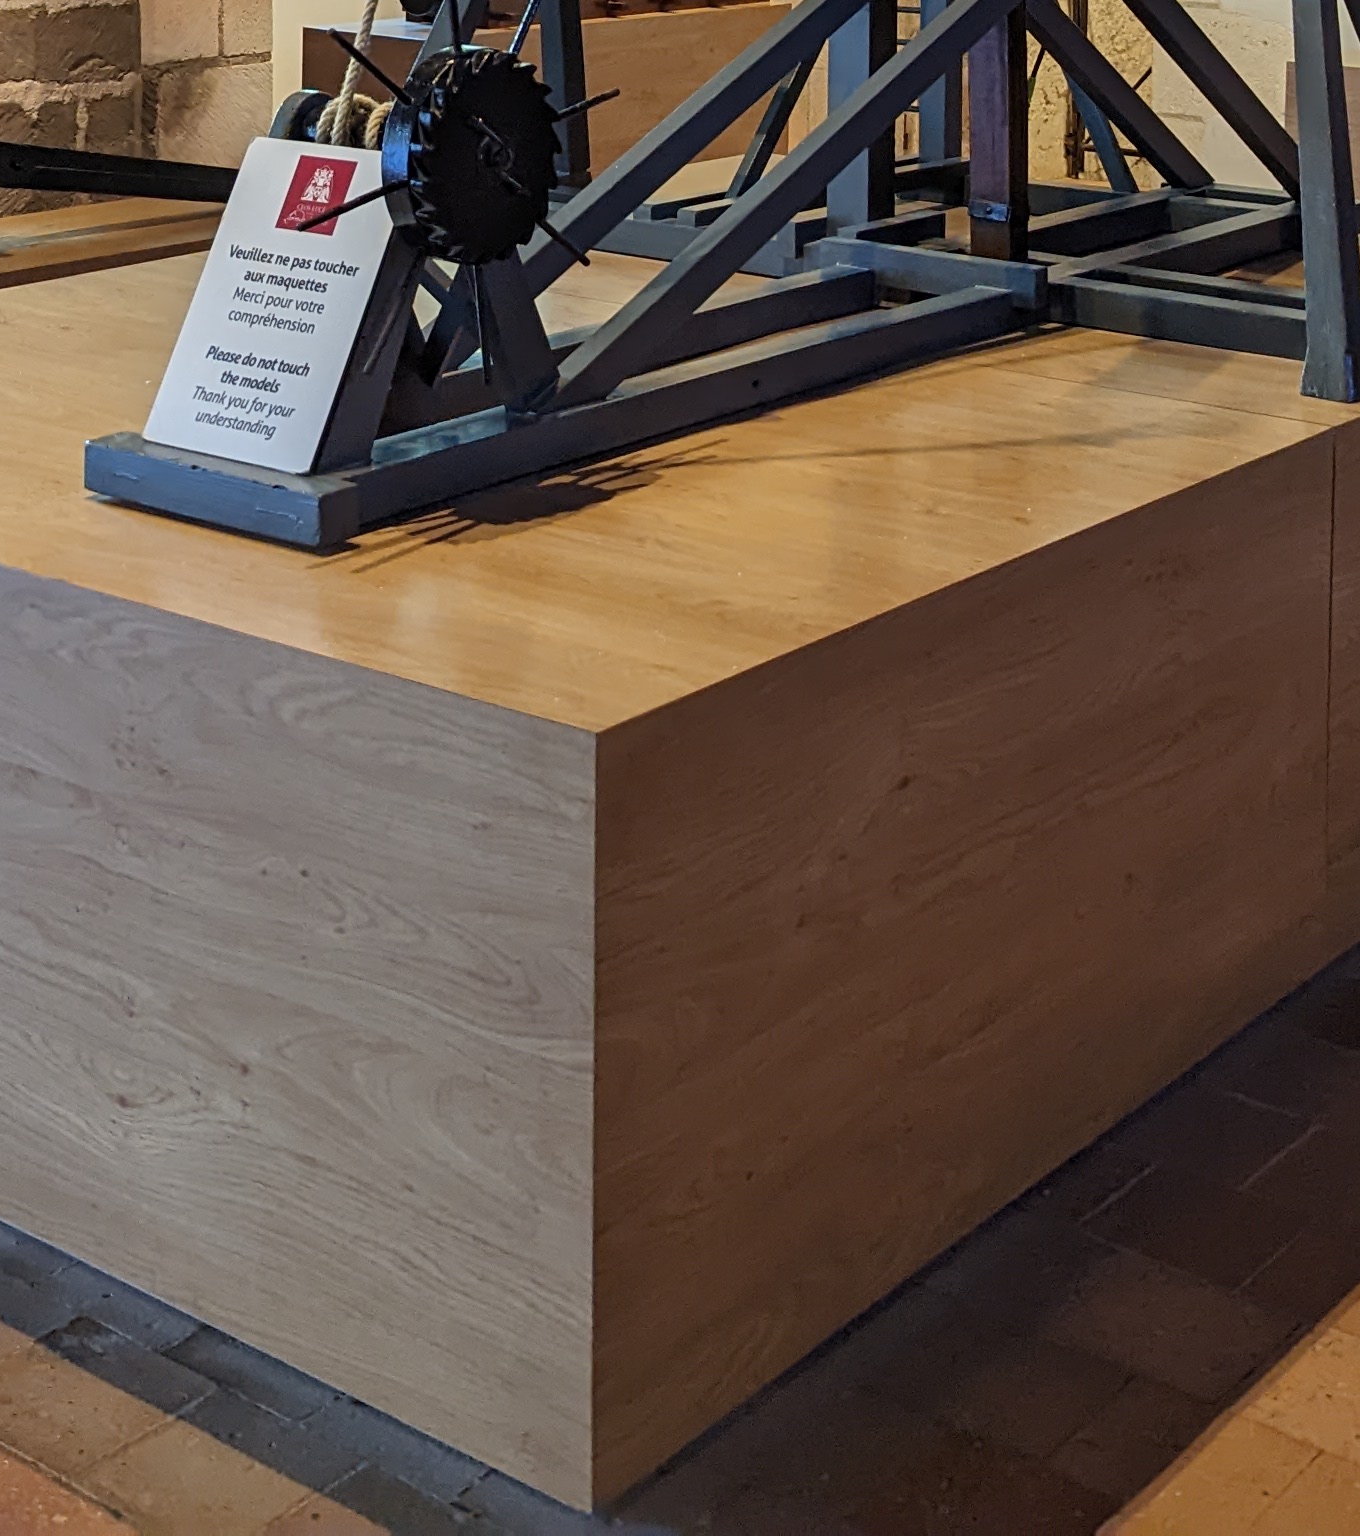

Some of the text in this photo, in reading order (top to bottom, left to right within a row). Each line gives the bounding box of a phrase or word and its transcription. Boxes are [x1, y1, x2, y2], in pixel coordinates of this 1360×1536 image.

[230, 244, 360, 277] Veuillez ne pas toucher
[244, 270, 328, 293] aux maquettes
[233, 287, 325, 314] Merci pour votre
[228, 310, 315, 334] compréhension
[206, 345, 310, 377] Please do not touch
[220, 370, 281, 393] the models
[193, 386, 296, 418] Thank you for your
[195, 411, 276, 440] understanding
